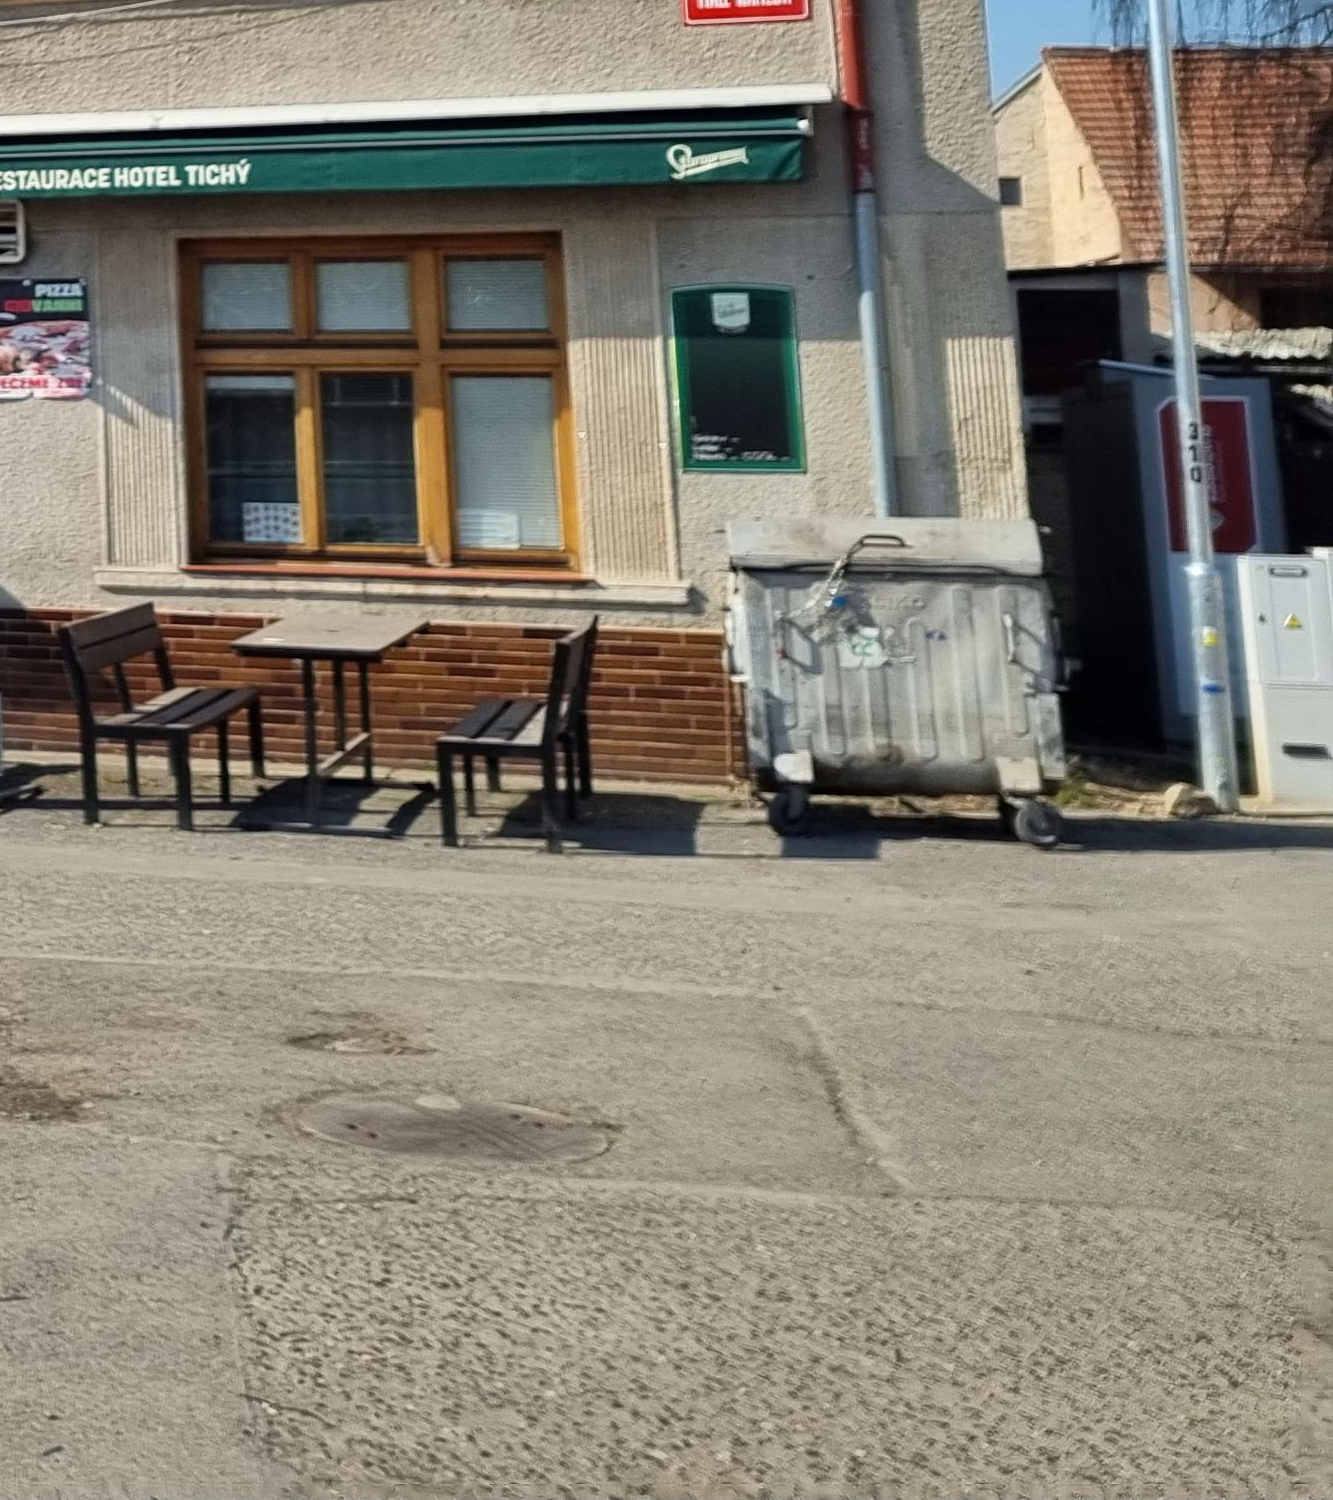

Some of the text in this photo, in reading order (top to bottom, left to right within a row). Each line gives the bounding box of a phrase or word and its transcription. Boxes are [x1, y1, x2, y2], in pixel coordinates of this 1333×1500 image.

[114, 164, 181, 188] HOTEL
[184, 158, 252, 187] TICHÝ
[34, 283, 84, 298] PIZZA
